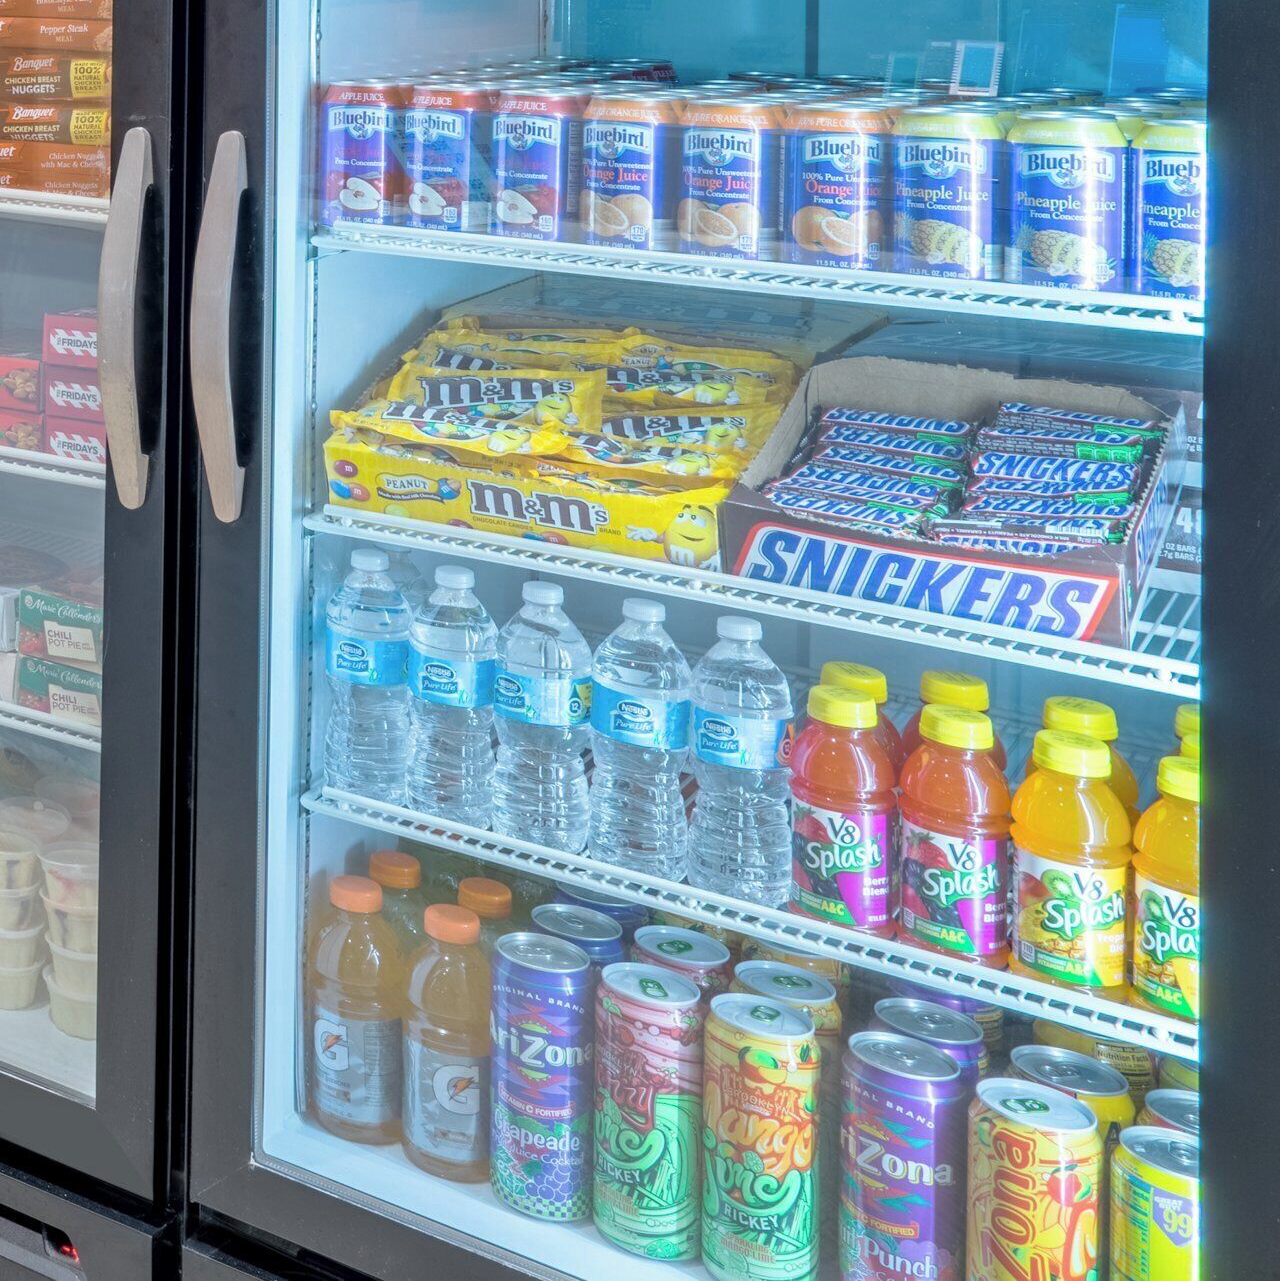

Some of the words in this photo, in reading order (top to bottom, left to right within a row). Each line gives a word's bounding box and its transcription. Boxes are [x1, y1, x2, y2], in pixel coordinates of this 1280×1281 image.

[39, 25, 66, 35] Pepper
[67, 24, 89, 34] Steak
[13, 56, 55, 72] Banquet
[4, 75, 36, 84] CHICKEN
[37, 75, 61, 83] BREAST
[11, 84, 56, 95] NUGGETS
[11, 106, 56, 120] Banquet
[74, 116, 102, 124] 100%
[333, 110, 392, 127] Bluebird
[2, 124, 34, 133] CHICKEN
[34, 124, 60, 132] BREAST
[405, 112, 457, 134] Bluebird
[495, 119, 553, 140] Bluebird
[585, 126, 645, 147] Bluebird
[688, 134, 753, 155] Bluebird
[48, 152, 75, 160] Chicken
[508, 170, 549, 180] Concentrate
[583, 167, 615, 182] Orange
[618, 168, 649, 183] Juice
[684, 173, 723, 189] Orange
[802, 172, 824, 182] 100%
[825, 173, 844, 182] Pure
[599, 181, 641, 191] Concentrate
[805, 180, 853, 196] Orange
[895, 181, 954, 201] Pineapple
[706, 189, 751, 200] Concentrate
[813, 195, 834, 204] From
[1016, 191, 1081, 212] Pineapple
[61, 337, 98, 350] FRIDAYS
[60, 390, 98, 403] FRIDAYS
[61, 441, 99, 455] FRIDAYS
[977, 451, 1136, 485] SNICKERS
[385, 478, 430, 491] PEANUT
[598, 527, 622, 536] BRAND
[746, 528, 1098, 641] SNICKERS
[47, 629, 72, 640] CHILI
[48, 638, 65, 647] POT
[65, 639, 81, 650] PIE
[51, 693, 77, 705] CHILI
[51, 702, 71, 711] POT
[72, 704, 88, 713] PIE
[826, 816, 857, 846] V8
[805, 840, 883, 878] Splash
[948, 841, 977, 870] V8
[922, 865, 1001, 905] Splash
[1073, 871, 1103, 901] V8
[820, 901, 845, 916] A&C
[1043, 892, 1124, 937] Splash
[1164, 894, 1197, 928] V8
[940, 929, 966, 944] A&C
[492, 984, 542, 1002] ORIGINAL
[548, 996, 585, 1015] BRAND
[1156, 986, 1183, 1005] A&C
[312, 1018, 351, 1072] G
[488, 1008, 593, 1069] AriZona
[432, 1065, 481, 1116] G
[885, 1100, 936, 1130] BRAND
[493, 1108, 581, 1153] Grapeade
[597, 1155, 642, 1184] RICKEY
[723, 1203, 780, 1232] RICKEY
[869, 1219, 916, 1236] FORTIFIED
[862, 1234, 939, 1280] Punch
